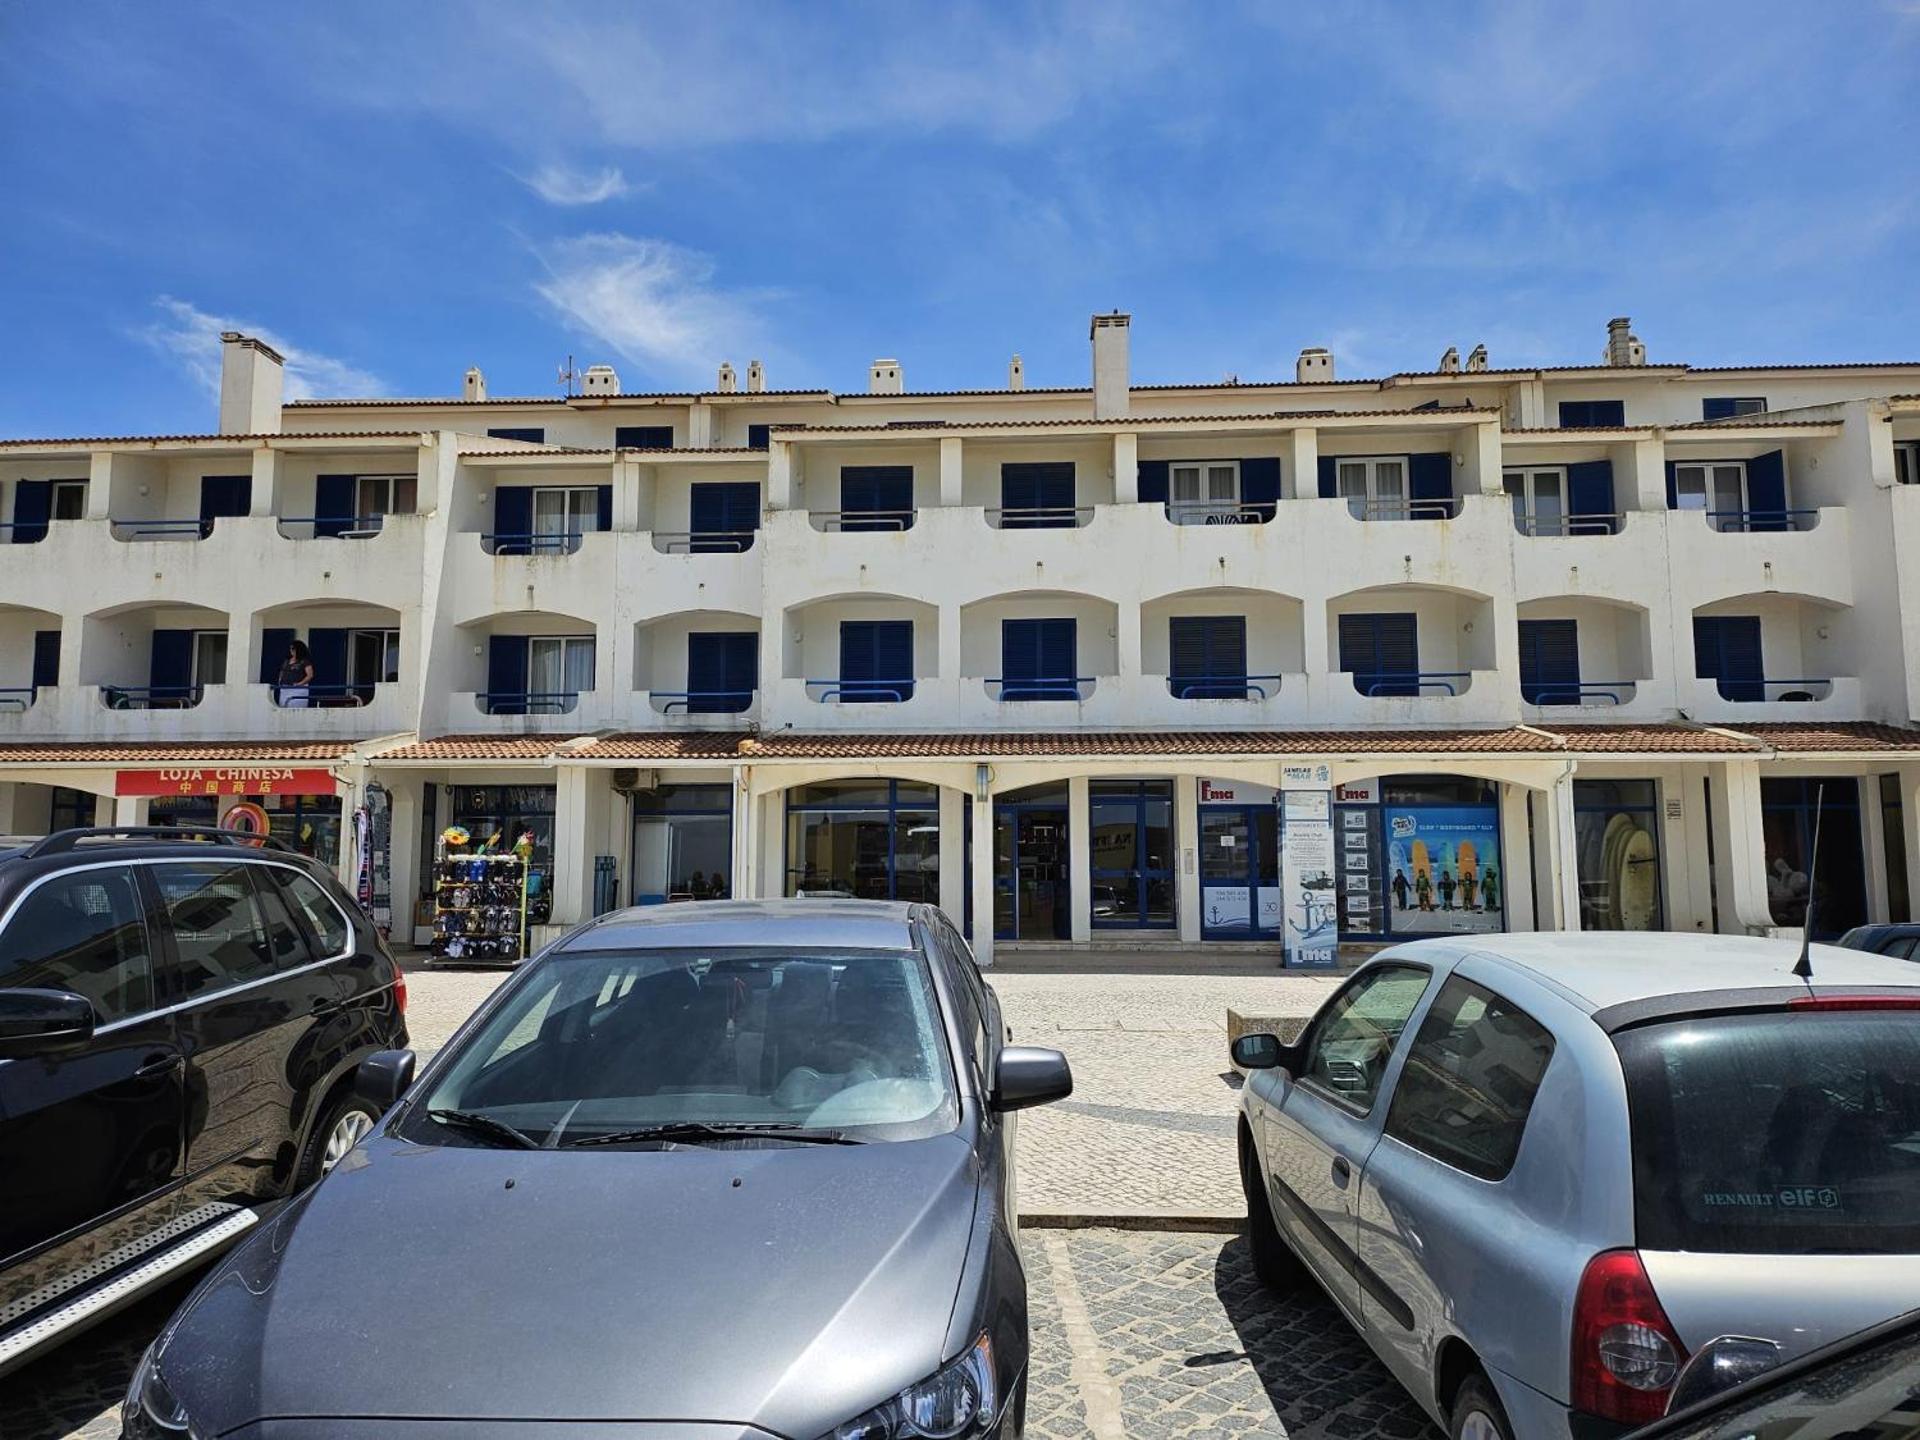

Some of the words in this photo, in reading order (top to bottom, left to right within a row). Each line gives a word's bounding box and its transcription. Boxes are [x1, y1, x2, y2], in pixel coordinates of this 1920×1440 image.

[160, 768, 202, 780] LOJA
[215, 768, 294, 780] CHINESA
[180, 781, 272, 793] 中国商店
[1704, 1194, 1774, 1206] RENAULT
[1780, 1189, 1817, 1206] elf
